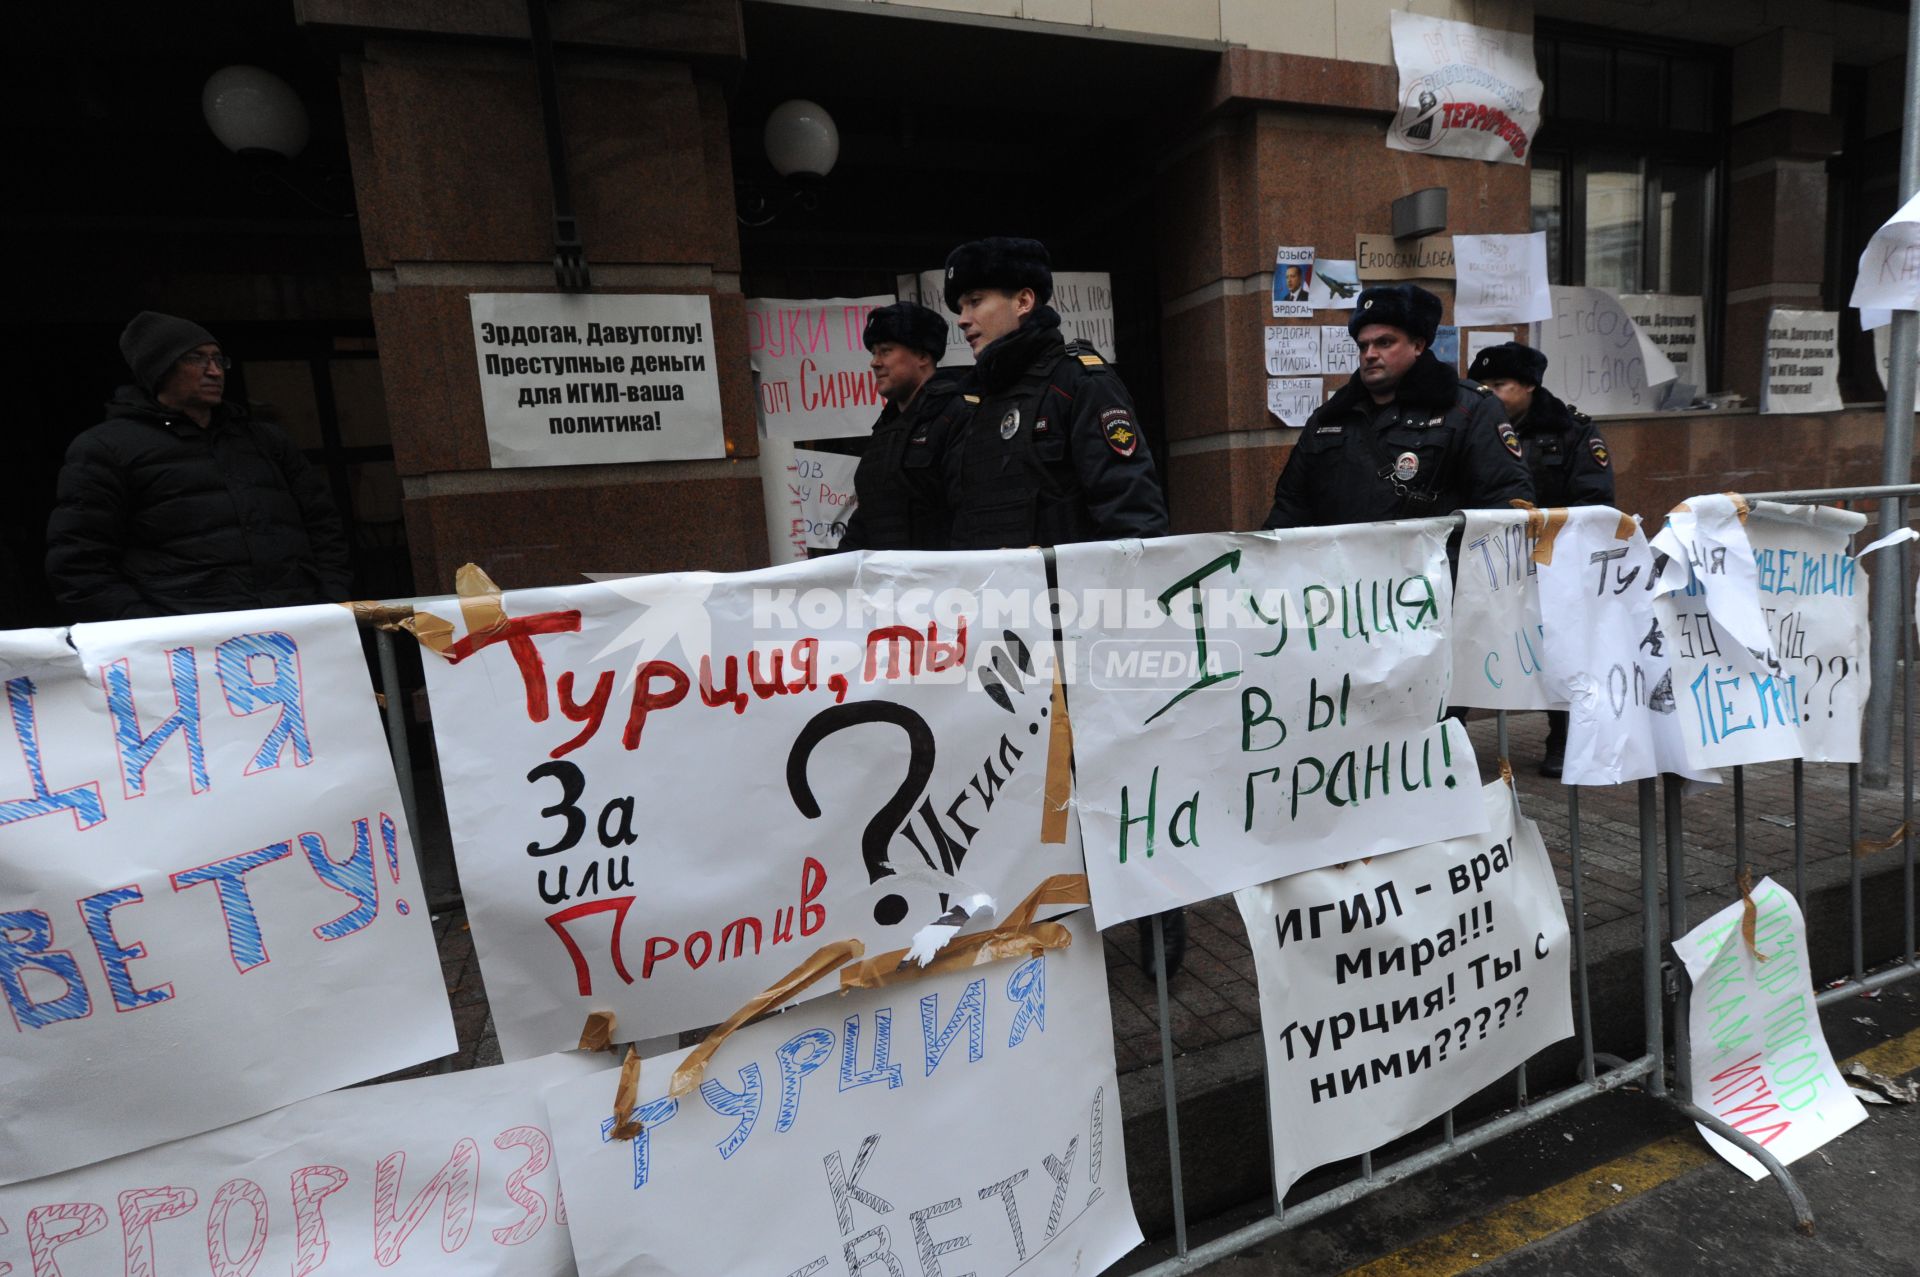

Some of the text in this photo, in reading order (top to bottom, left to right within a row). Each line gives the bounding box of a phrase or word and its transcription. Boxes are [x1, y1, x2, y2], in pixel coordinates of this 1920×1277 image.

[481, 322, 703, 346] Эрдоган, Давутоглу!
[485, 353, 706, 377] Преступные деньги
[517, 382, 684, 408] для ИГИЛ-ваша
[549, 410, 662, 434] политика!
[449, 609, 850, 758] Турция,
[526, 760, 638, 857] За
[537, 855, 635, 905] или
[1275, 881, 1403, 950] ИГИЛ
[1468, 948, 1522, 990] Ты
